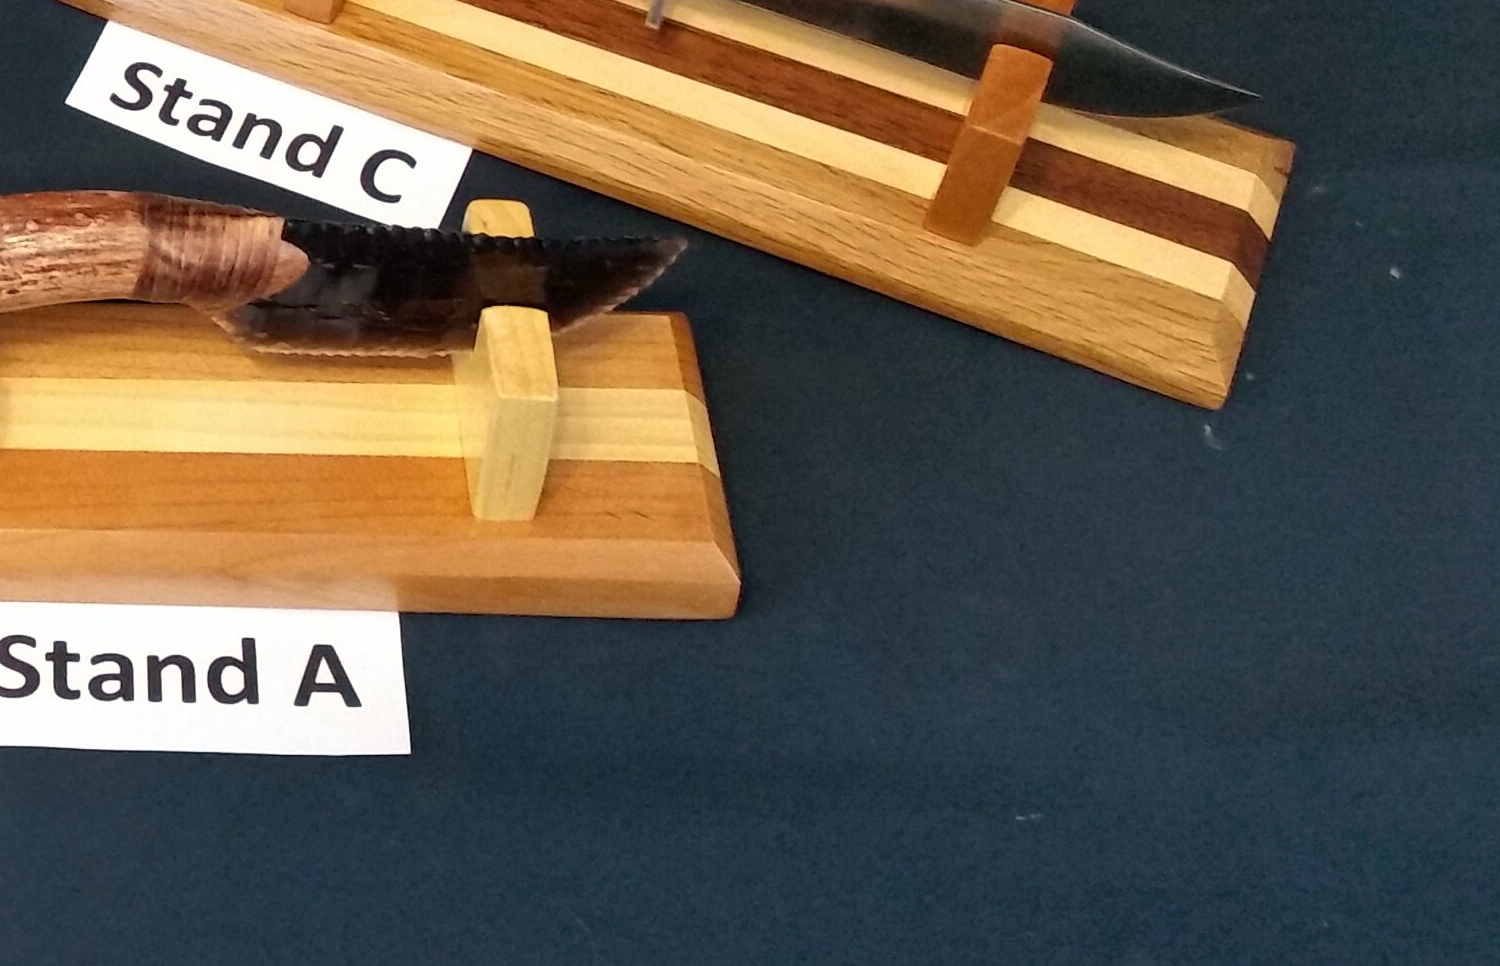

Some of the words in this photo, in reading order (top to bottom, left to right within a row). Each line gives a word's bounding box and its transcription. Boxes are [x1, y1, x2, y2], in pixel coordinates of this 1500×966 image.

[109, 61, 345, 180] Stand
[359, 148, 417, 203] C
[293, 644, 363, 708] A
